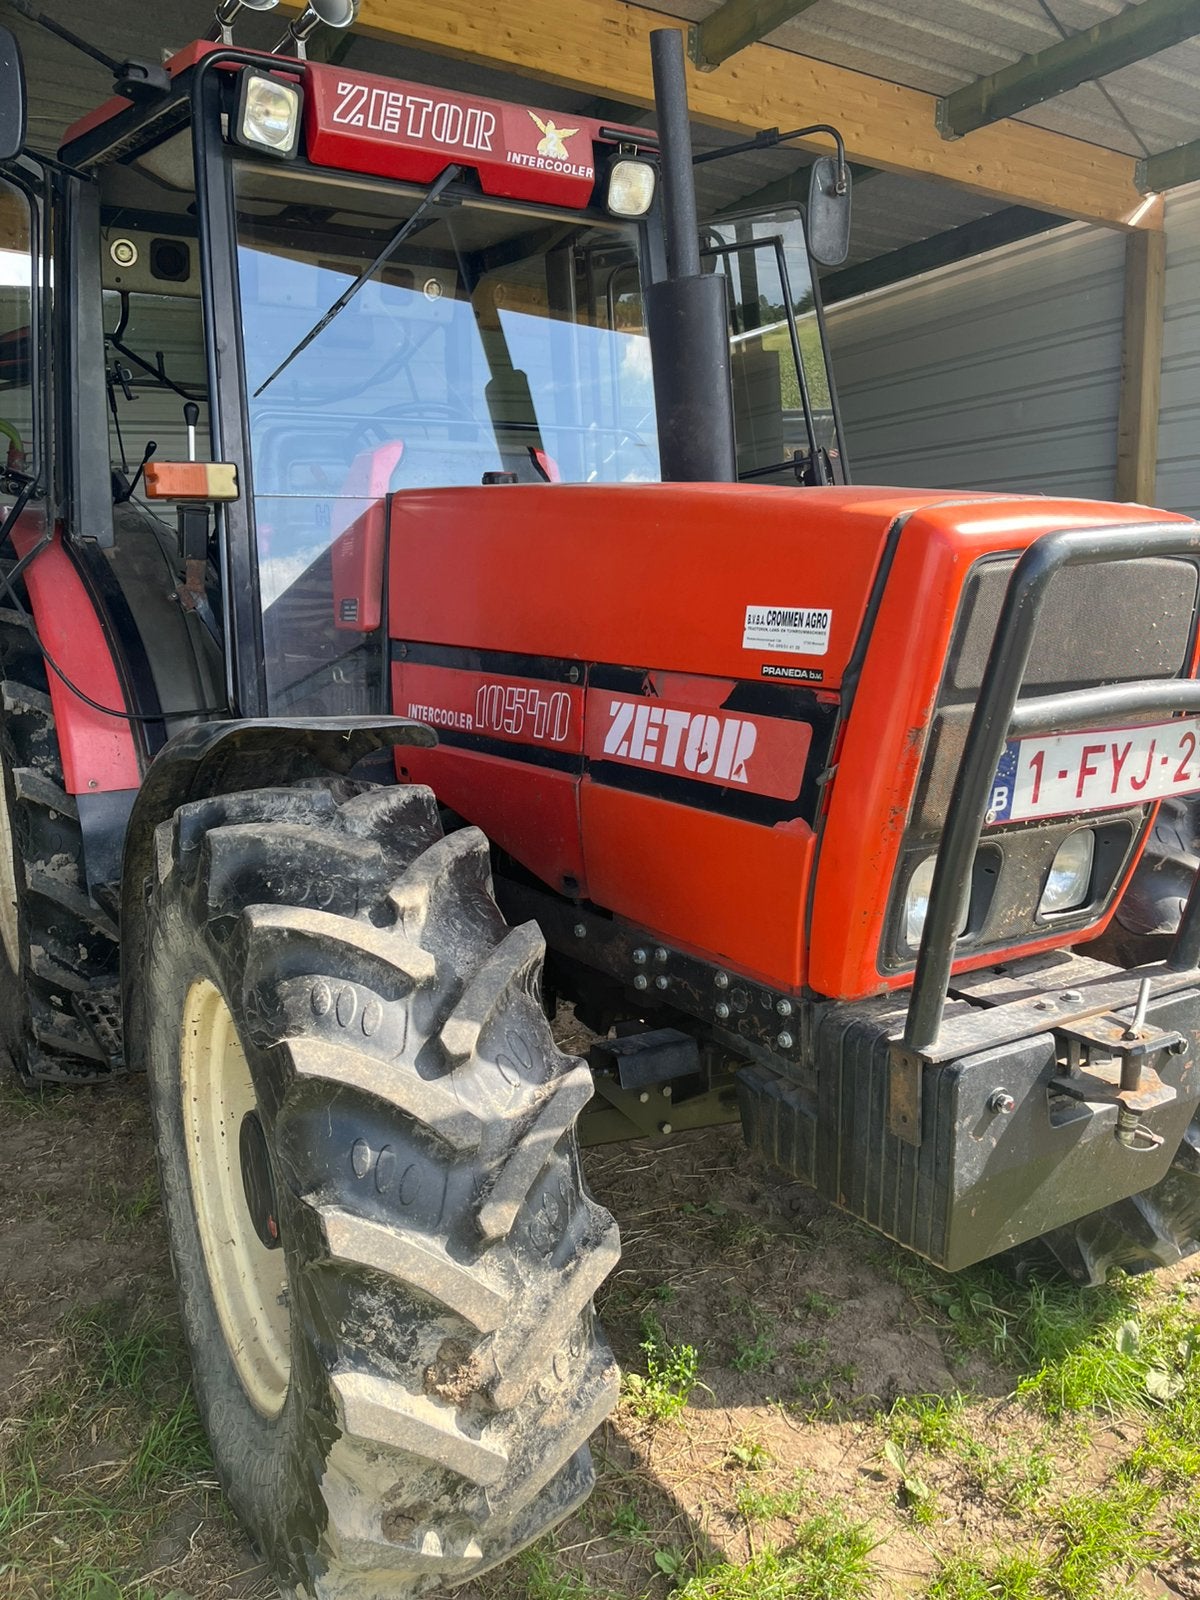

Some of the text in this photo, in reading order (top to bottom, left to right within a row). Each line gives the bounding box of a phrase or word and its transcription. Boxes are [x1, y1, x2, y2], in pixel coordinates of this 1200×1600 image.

[332, 81, 496, 152] ZETOR
[506, 151, 594, 178] INTERCOOLER
[766, 610, 805, 628] CROMMEN
[805, 611, 828, 629] AGRO
[762, 666, 808, 678] PRANEDA
[407, 703, 473, 731] INTERCOOLER
[474, 684, 572, 742] 10540
[603, 700, 758, 784] ZETOR
[1028, 730, 1200, 805] 1-FYJ-2
[990, 786, 1009, 812] B
